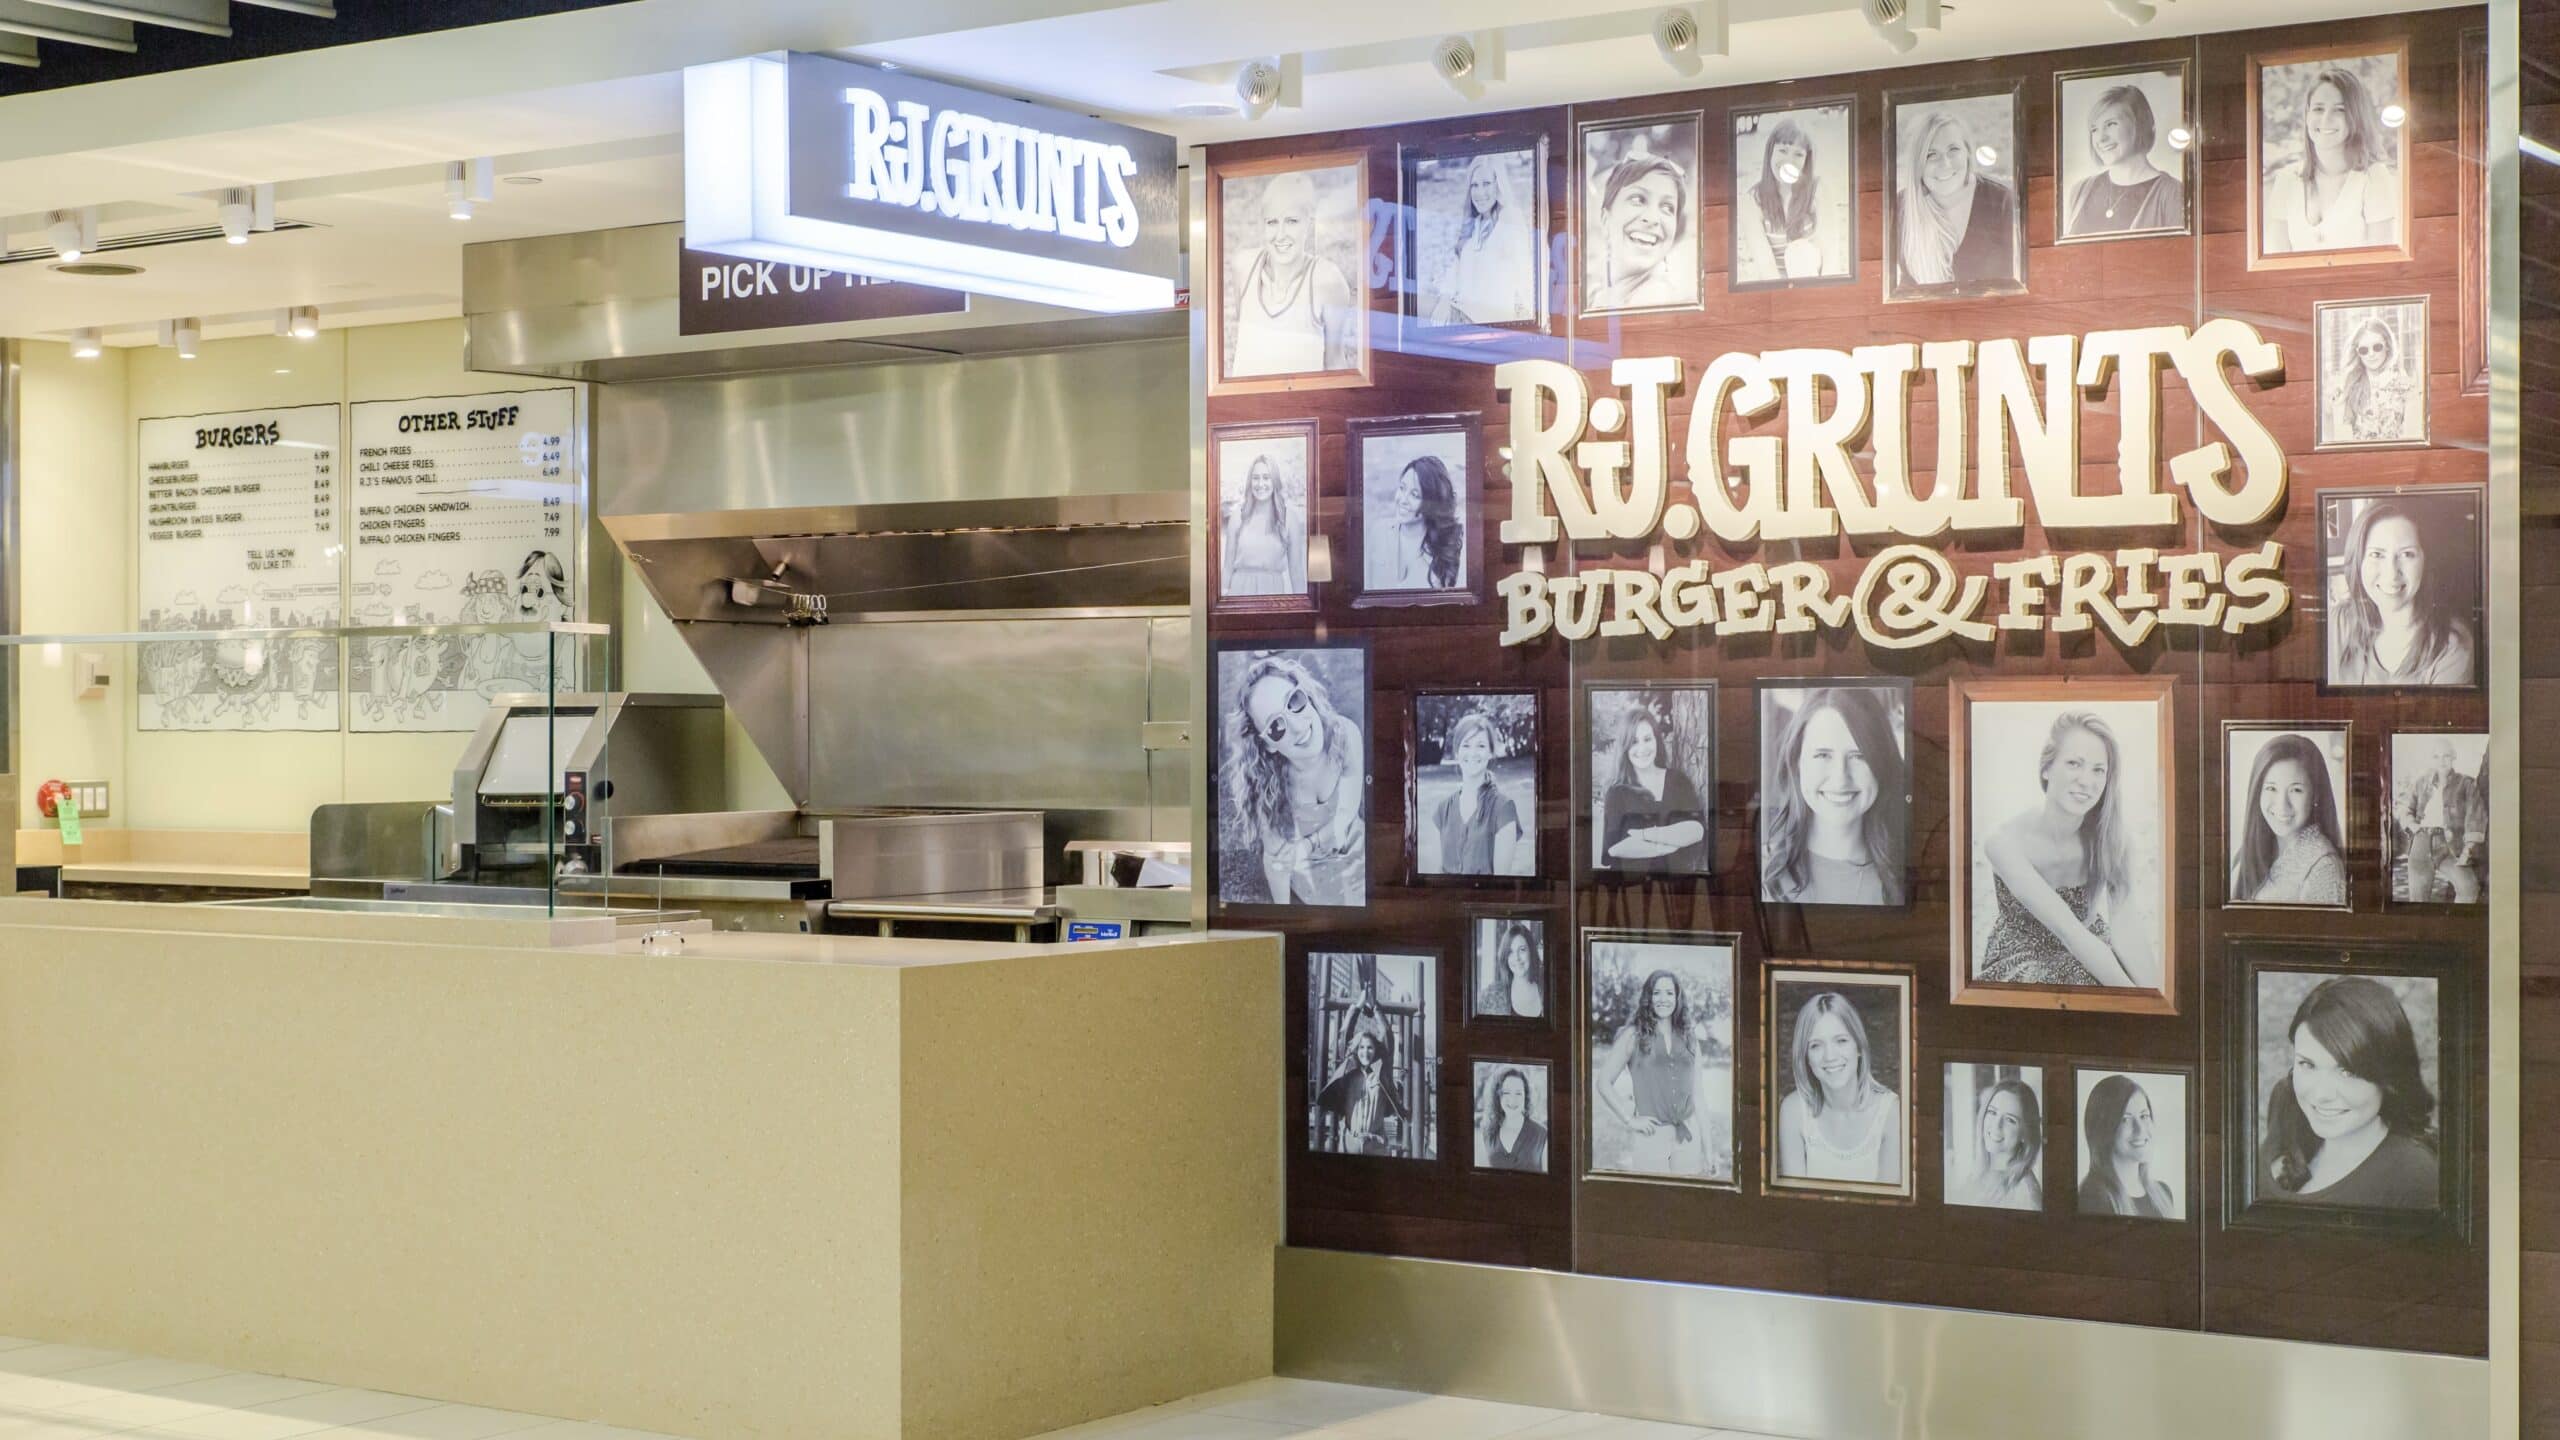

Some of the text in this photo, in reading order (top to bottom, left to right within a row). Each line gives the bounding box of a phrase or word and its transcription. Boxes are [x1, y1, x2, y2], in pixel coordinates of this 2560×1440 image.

[702, 261, 779, 301] PICK
[789, 264, 832, 293] UP
[399, 405, 520, 433] OTHER STUFF
[195, 420, 281, 449] BURGERS
[360, 436, 560, 457] FRENCH FRIES 4.99
[360, 452, 560, 472] CHILI CHEESE FRIES 6.49
[149, 465, 330, 485] CHEESEBURGER 7.49
[382, 475, 412, 485] FAMOUS
[542, 467, 560, 477] 6.49
[176, 487, 198, 497] BACON
[200, 485, 231, 496] CHEDDAR
[234, 483, 261, 493] BURGER
[191, 514, 213, 524] SWISS
[216, 513, 242, 523] BURGER
[360, 505, 390, 516] BUFFALO
[394, 504, 426, 514] CHICKEN
[360, 512, 560, 530] CHICKEN FINGERS 7.49
[176, 529, 202, 539] BURGER
[315, 523, 330, 532] 7.49
[360, 528, 560, 544] BUFFALO CHICKEN FINGERS 7.99
[247, 548, 295, 559] TELL US HOW
[247, 561, 261, 570] YOU
[263, 560, 279, 570] LIKE
[1497, 541, 2292, 650] BURGER & FRIES
